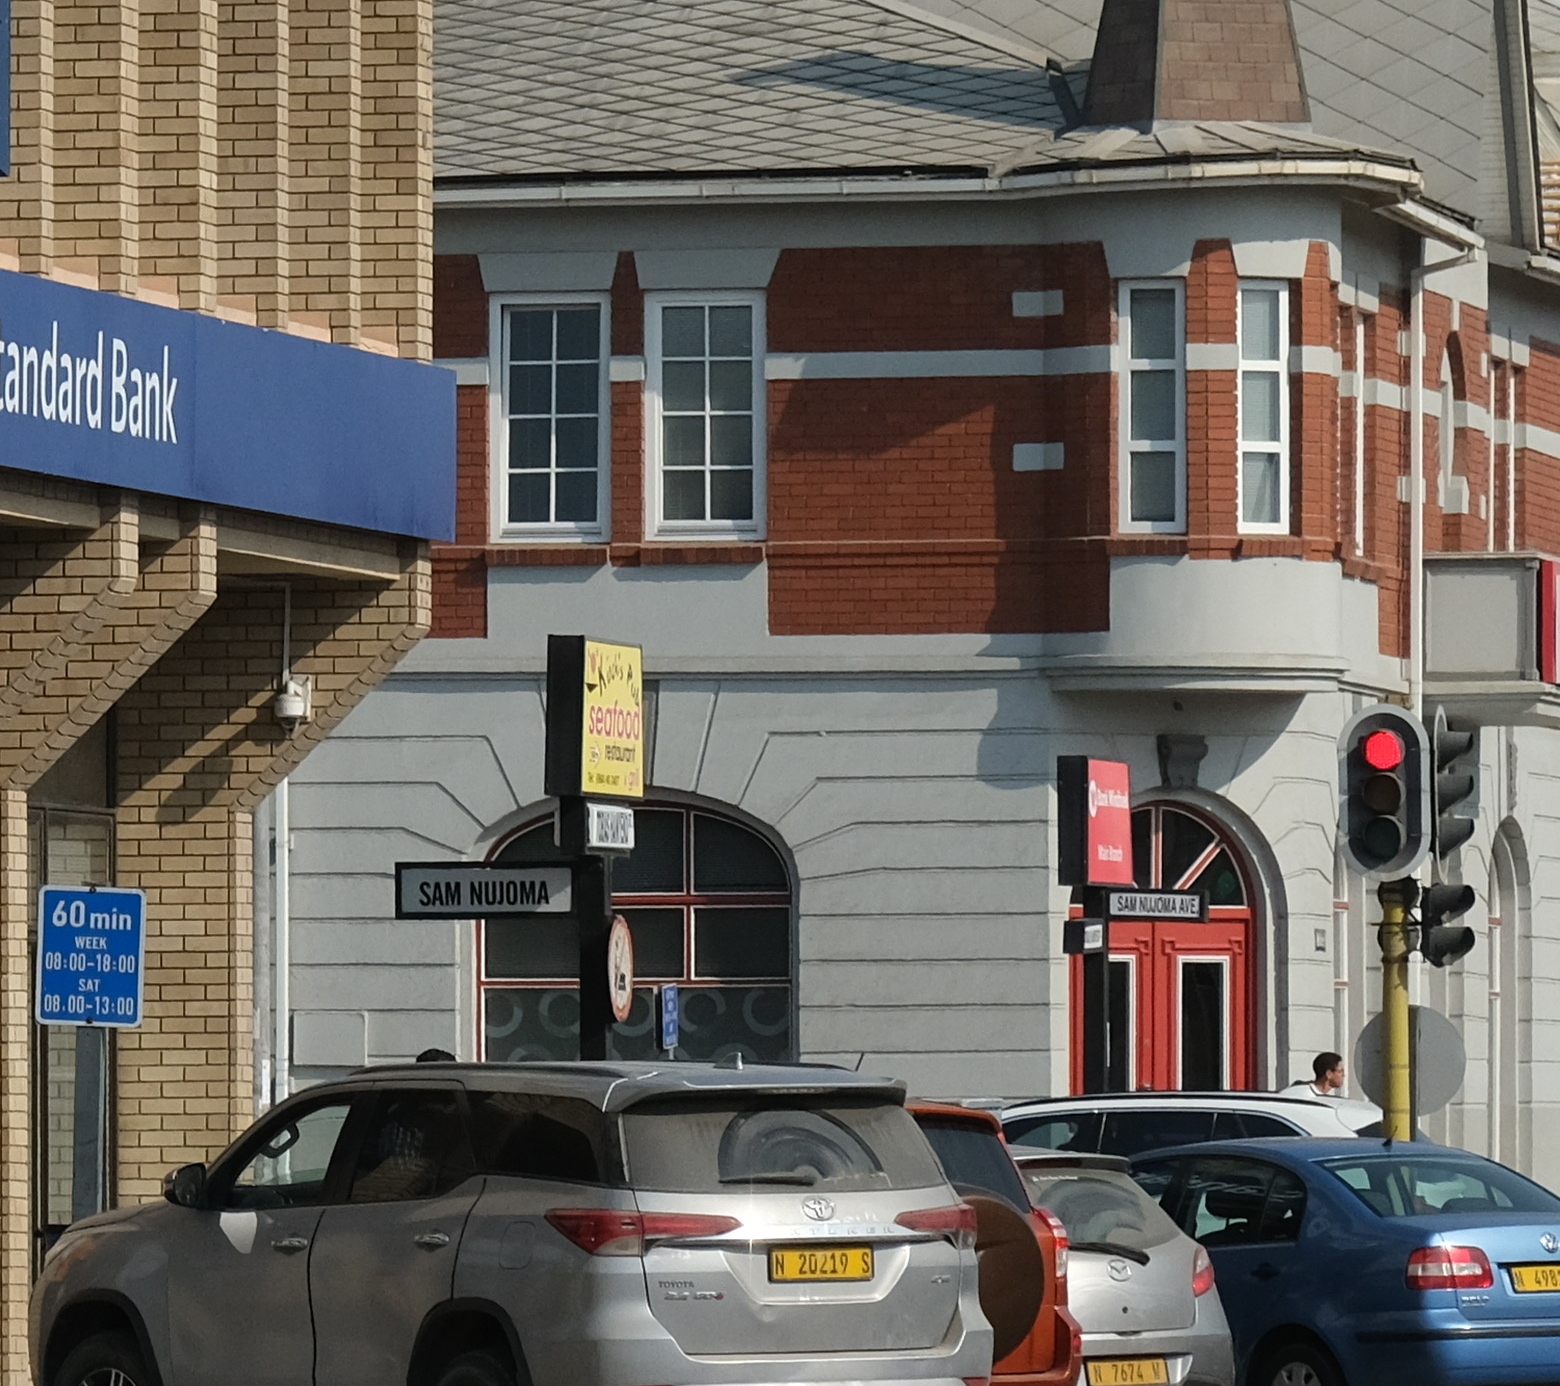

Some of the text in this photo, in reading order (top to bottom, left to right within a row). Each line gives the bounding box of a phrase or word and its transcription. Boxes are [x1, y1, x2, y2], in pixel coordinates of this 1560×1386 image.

[110, 337, 178, 445] Bank
[588, 700, 641, 741] seafood
[418, 879, 551, 907] SAM NUJOMA
[1116, 894, 1138, 912] SAM
[1139, 895, 1177, 913] NUJOMA
[52, 899, 133, 931] 60 min
[74, 935, 108, 950] WEEK
[44, 951, 136, 974] 08:00-18:00
[78, 977, 101, 993] SAT
[775, 1252, 870, 1276] N 20219 S
[1514, 1271, 1524, 1288] N
[1094, 1366, 1103, 1383] N
